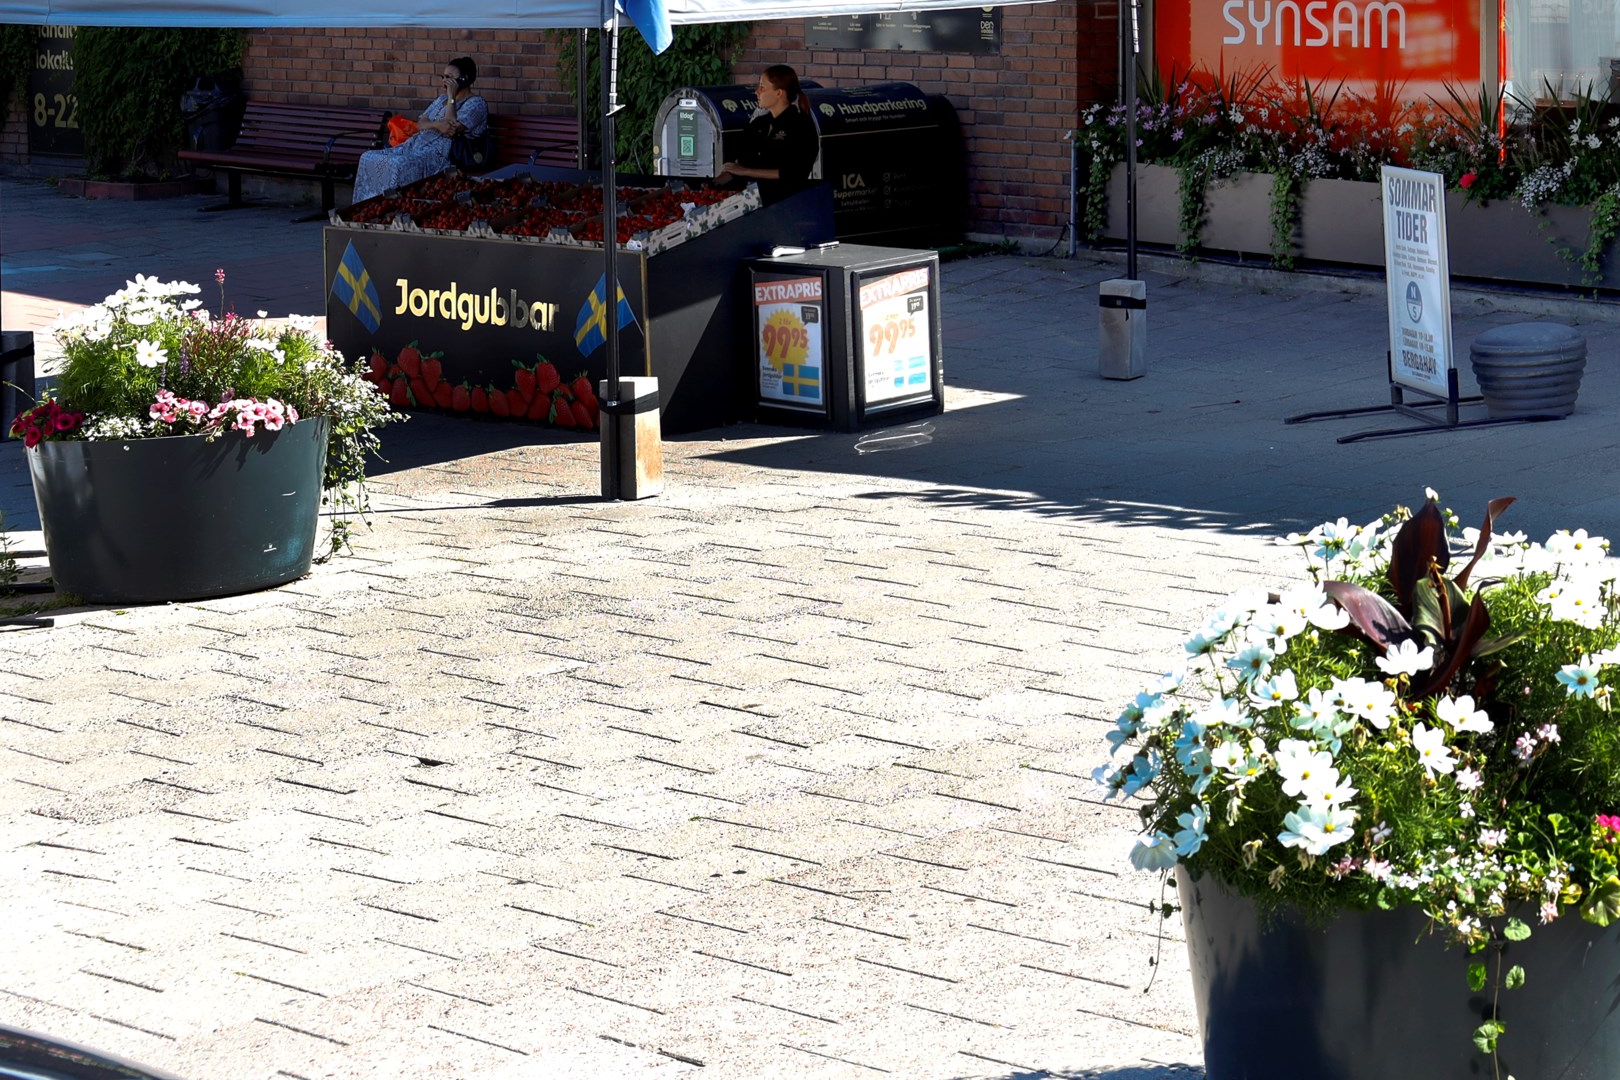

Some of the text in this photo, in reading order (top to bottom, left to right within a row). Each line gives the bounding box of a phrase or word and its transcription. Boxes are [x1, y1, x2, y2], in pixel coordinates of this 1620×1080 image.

[1222, 0, 1406, 49] SYNSAM
[33, 92, 80, 128] 8-22
[837, 97, 928, 115] Hundparkering
[842, 172, 866, 190] ICA
[1388, 176, 1436, 213] SOMMAR
[1396, 210, 1428, 244] TIDER
[754, 281, 822, 302] EXTRAPRIS
[861, 269, 929, 304] EXTRAPRIS
[1410, 286, 1417, 299] N
[395, 278, 560, 332] Jordgubbar
[1412, 306, 1418, 318] S
